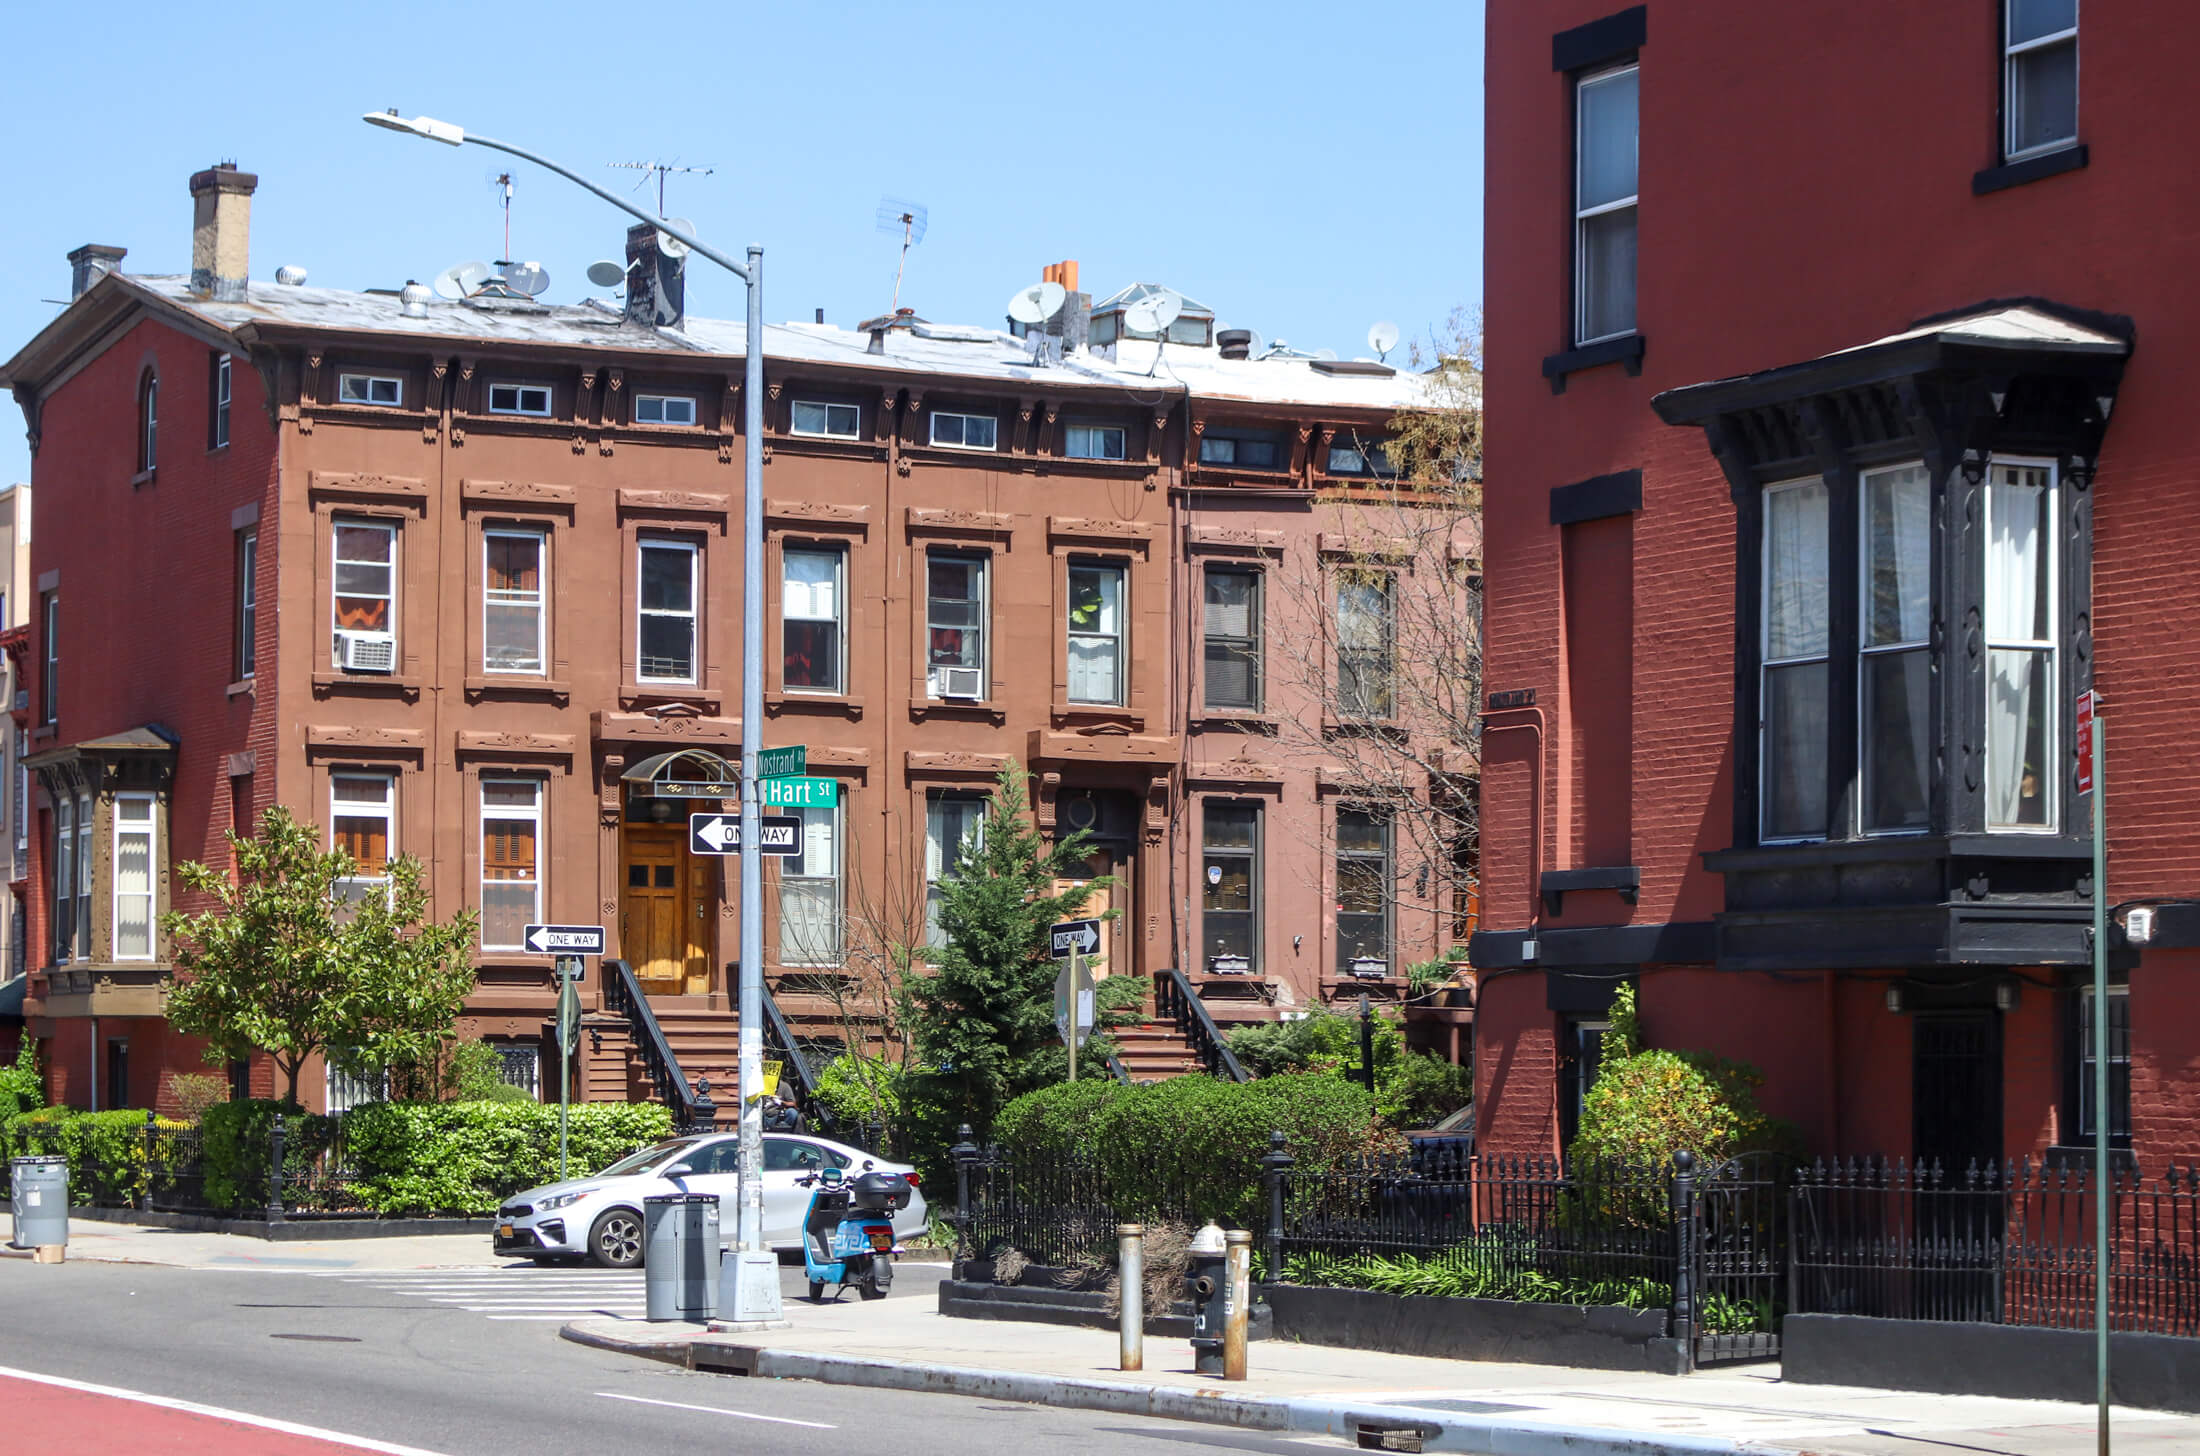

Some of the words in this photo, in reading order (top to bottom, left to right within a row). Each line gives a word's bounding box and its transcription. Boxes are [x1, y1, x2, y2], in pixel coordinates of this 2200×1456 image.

[758, 749, 794, 776] Nostrand
[770, 781, 811, 803] Hart
[818, 782, 830, 796] St
[724, 827, 741, 842] ON
[761, 828, 789, 843] WAY
[548, 934, 570, 945] ONE
[574, 935, 595, 945] WAY
[1056, 934, 1070, 947] ONE
